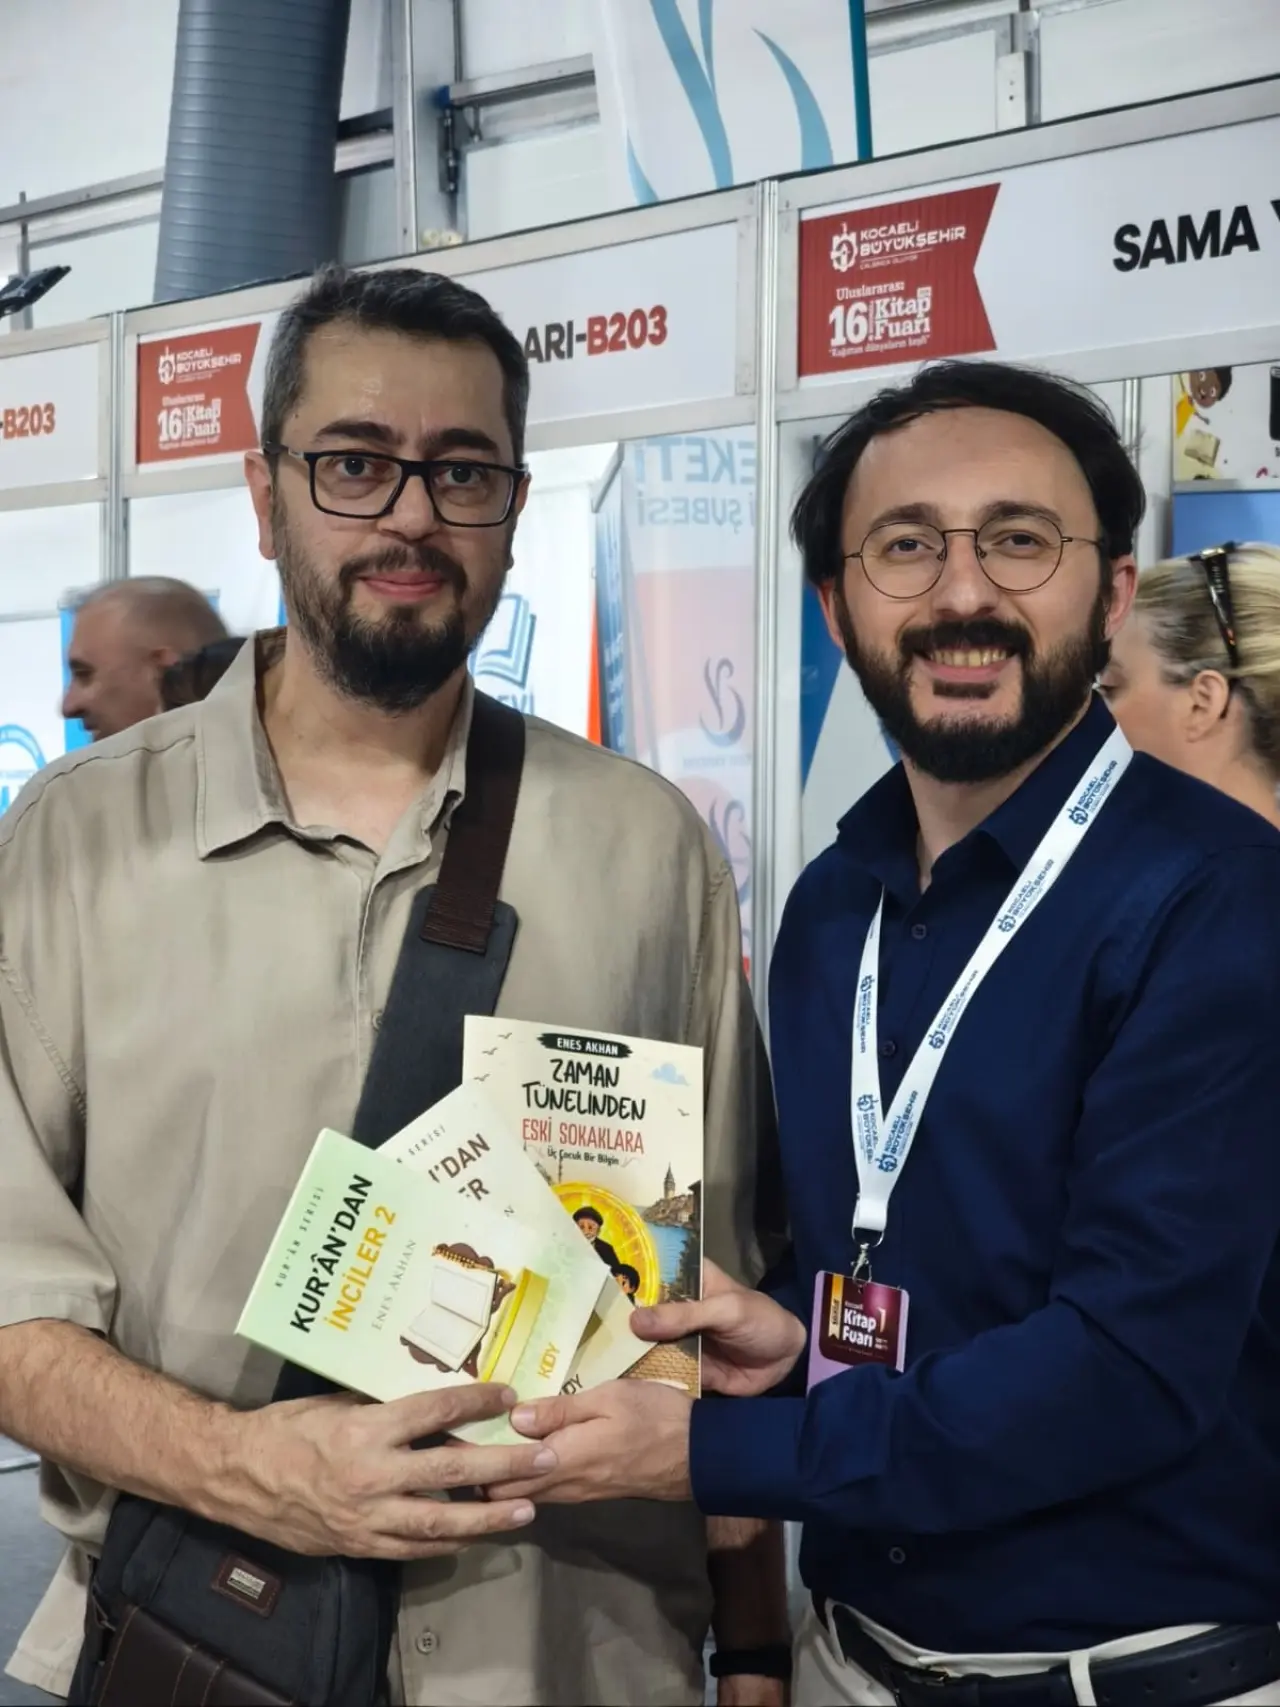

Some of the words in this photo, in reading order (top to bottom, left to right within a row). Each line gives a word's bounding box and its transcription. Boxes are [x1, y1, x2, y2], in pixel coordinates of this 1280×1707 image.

[1112, 204, 1261, 273] SAMA
[875, 296, 932, 319] Kitap
[157, 407, 182, 442] 16
[557, 1037, 582, 1051] ENES
[585, 1040, 619, 1057] AKHAN
[550, 1058, 620, 1088] ZAMAN
[522, 1081, 646, 1121] TÜNELİNDEN
[522, 1116, 553, 1142] ESKİ
[559, 1122, 645, 1155] SOKAKLARA
[584, 1152, 595, 1162] Bir
[323, 1227, 387, 1331] İNCİLER
[374, 1205, 396, 1225] 2
[844, 1308, 876, 1332] Kitap
